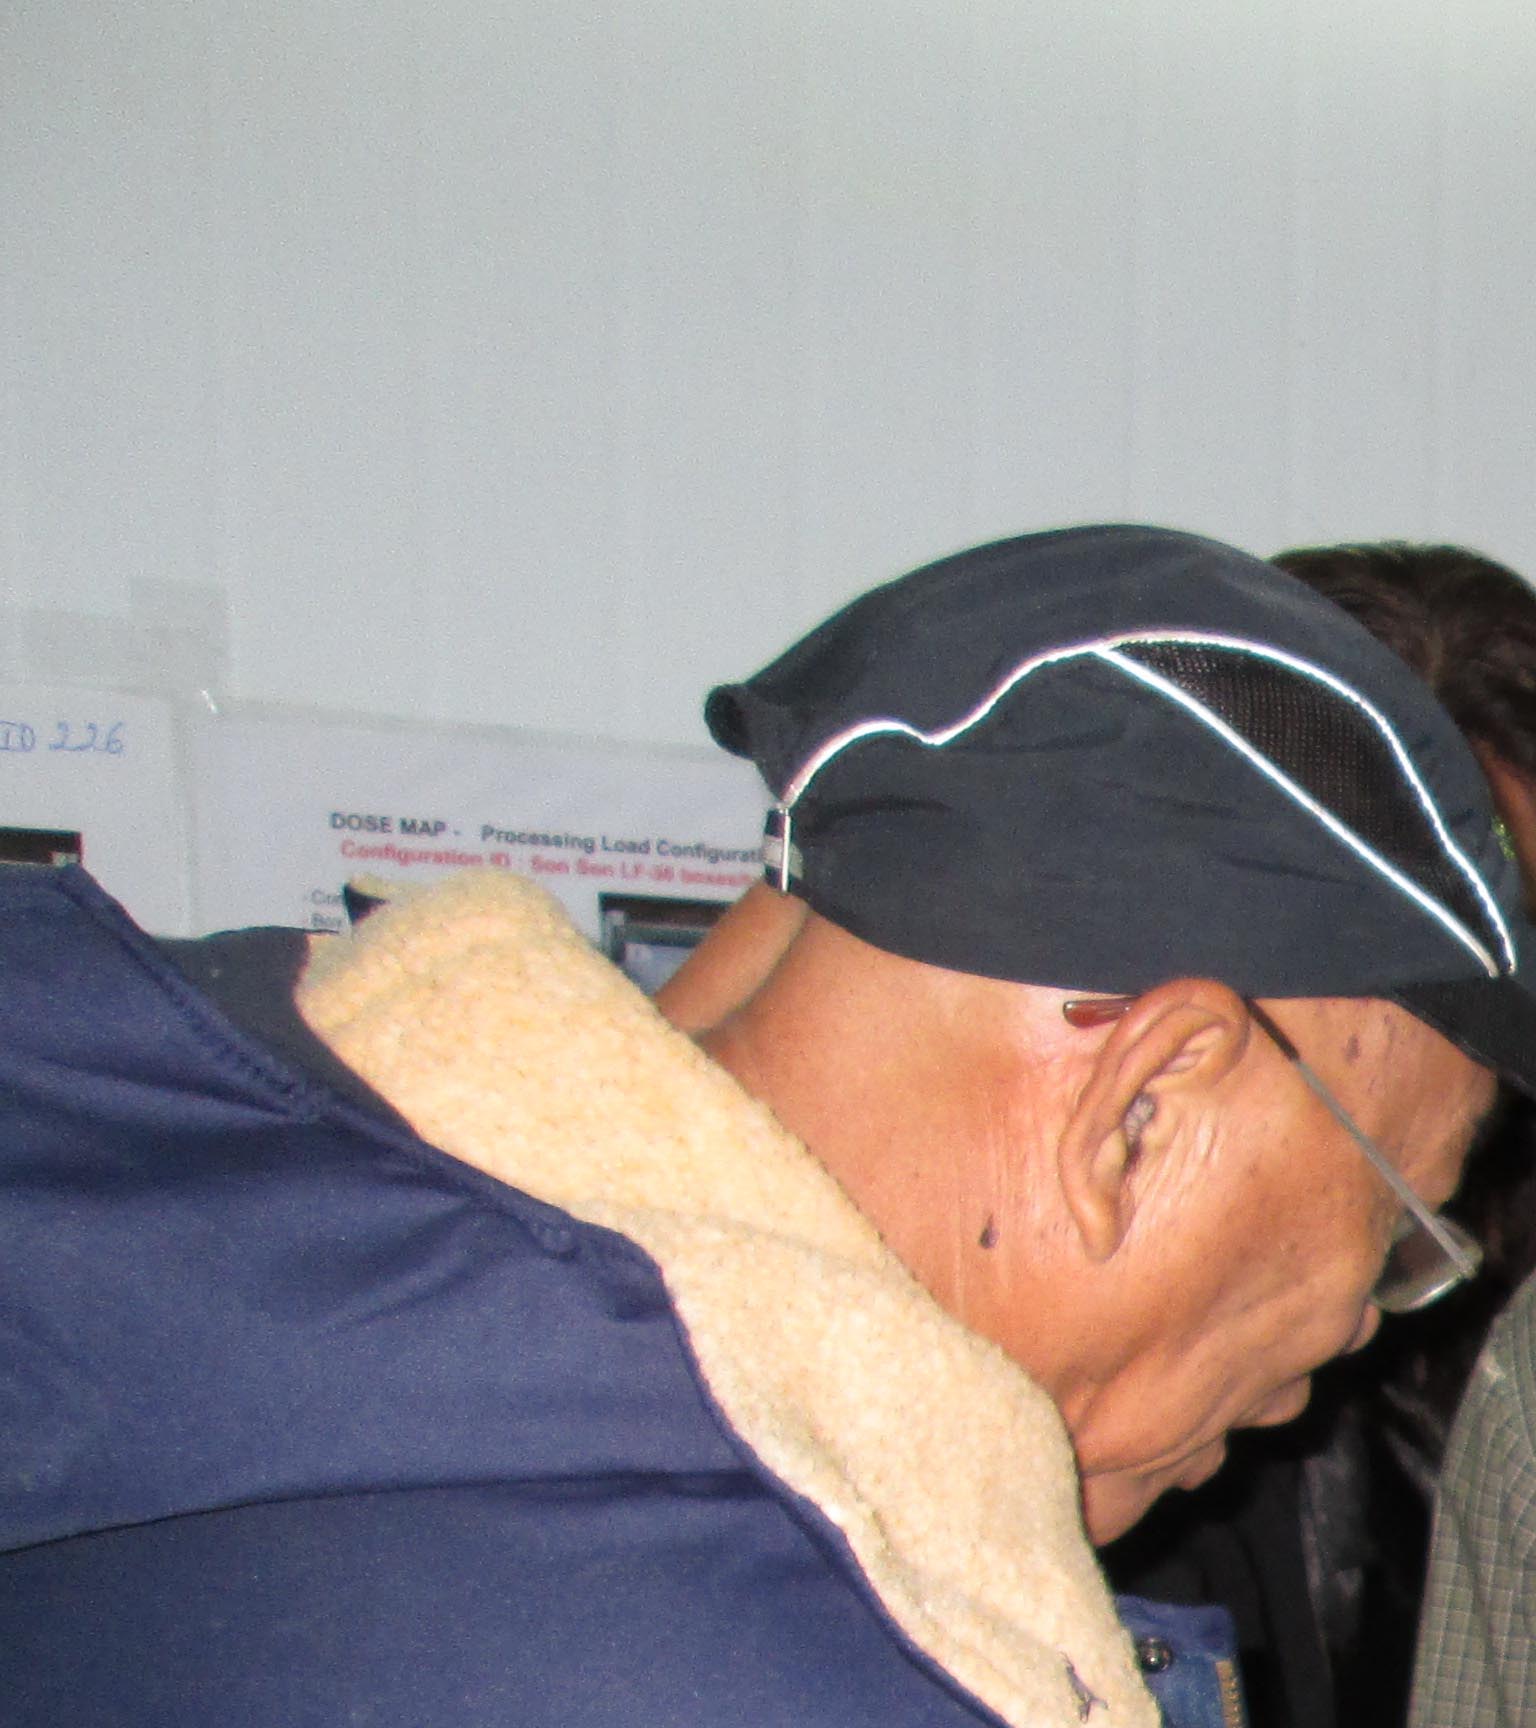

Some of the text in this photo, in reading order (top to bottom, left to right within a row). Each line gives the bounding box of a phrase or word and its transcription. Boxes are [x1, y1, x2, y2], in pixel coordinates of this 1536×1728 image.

[48, 721, 125, 755] 226
[330, 811, 393, 833] DOSE
[400, 817, 447, 837] MAP
[481, 823, 596, 854] Processing
[601, 835, 651, 855] Load
[340, 840, 484, 867] Configuration
